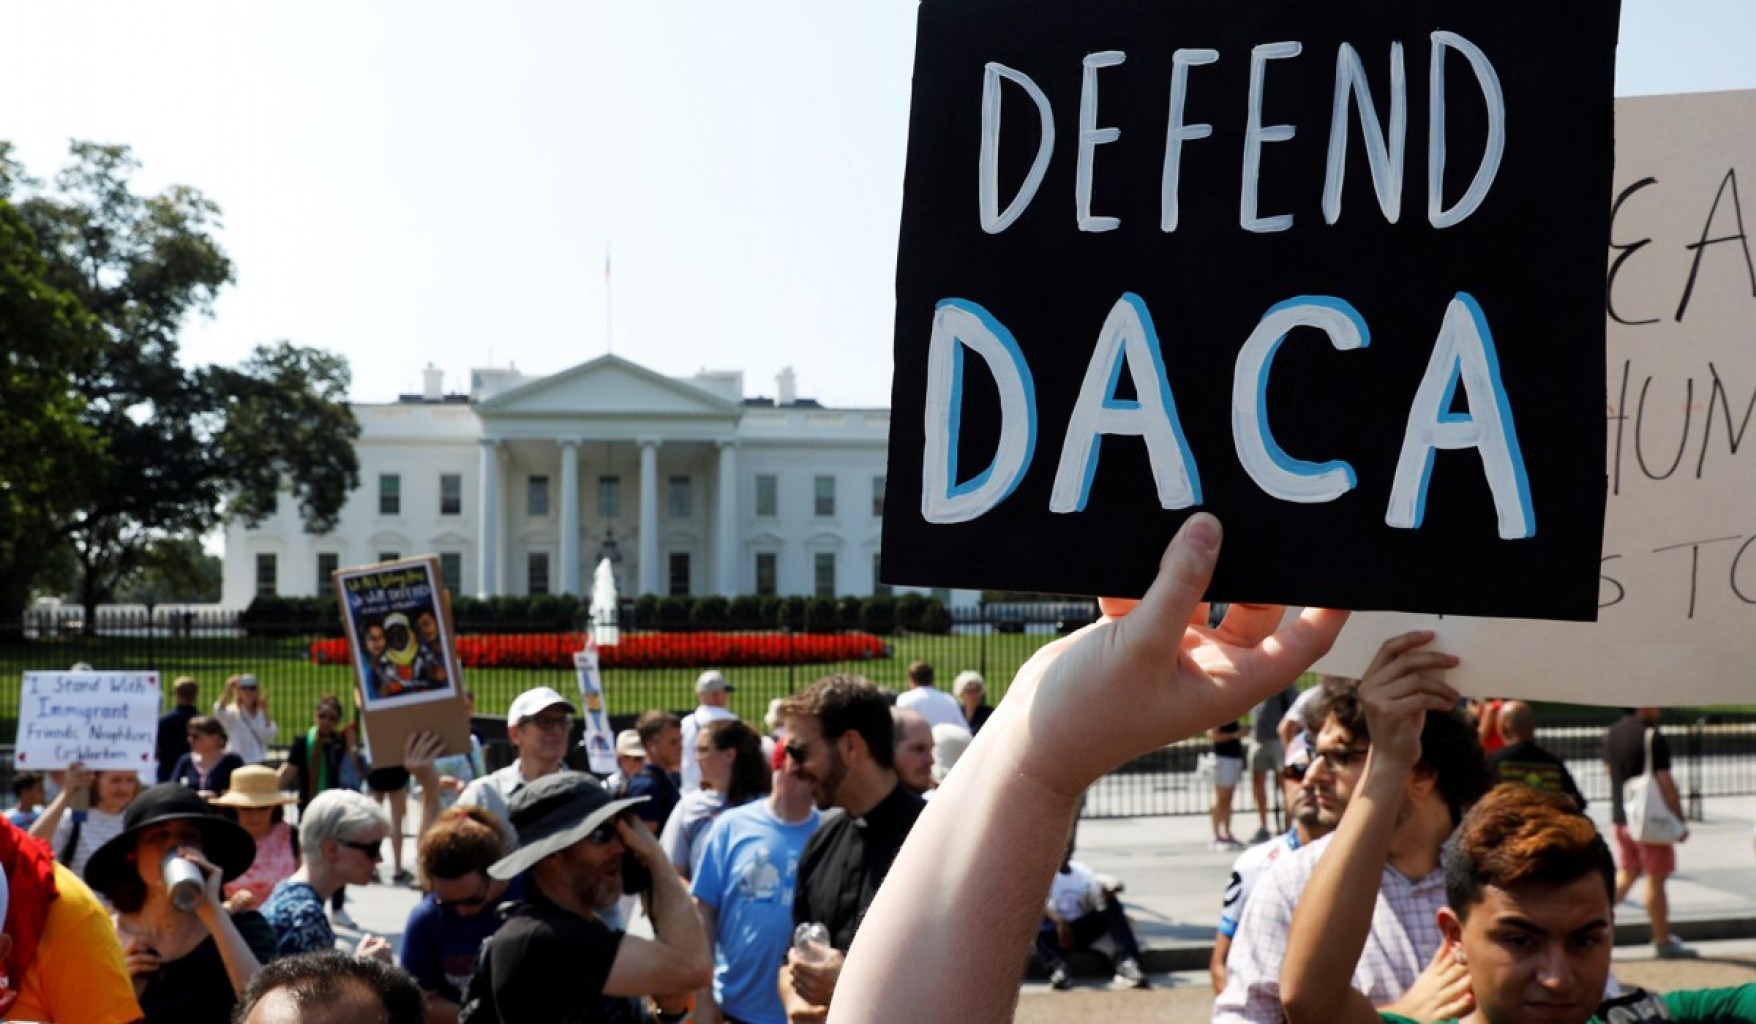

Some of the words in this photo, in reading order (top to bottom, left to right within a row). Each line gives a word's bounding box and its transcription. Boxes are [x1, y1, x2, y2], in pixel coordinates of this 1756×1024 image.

[979, 30, 1506, 234] DEFEND
[922, 292, 1537, 540] DACA
[38, 696, 129, 724] Immigrant
[53, 676, 101, 693] Stand
[110, 677, 146, 693] With
